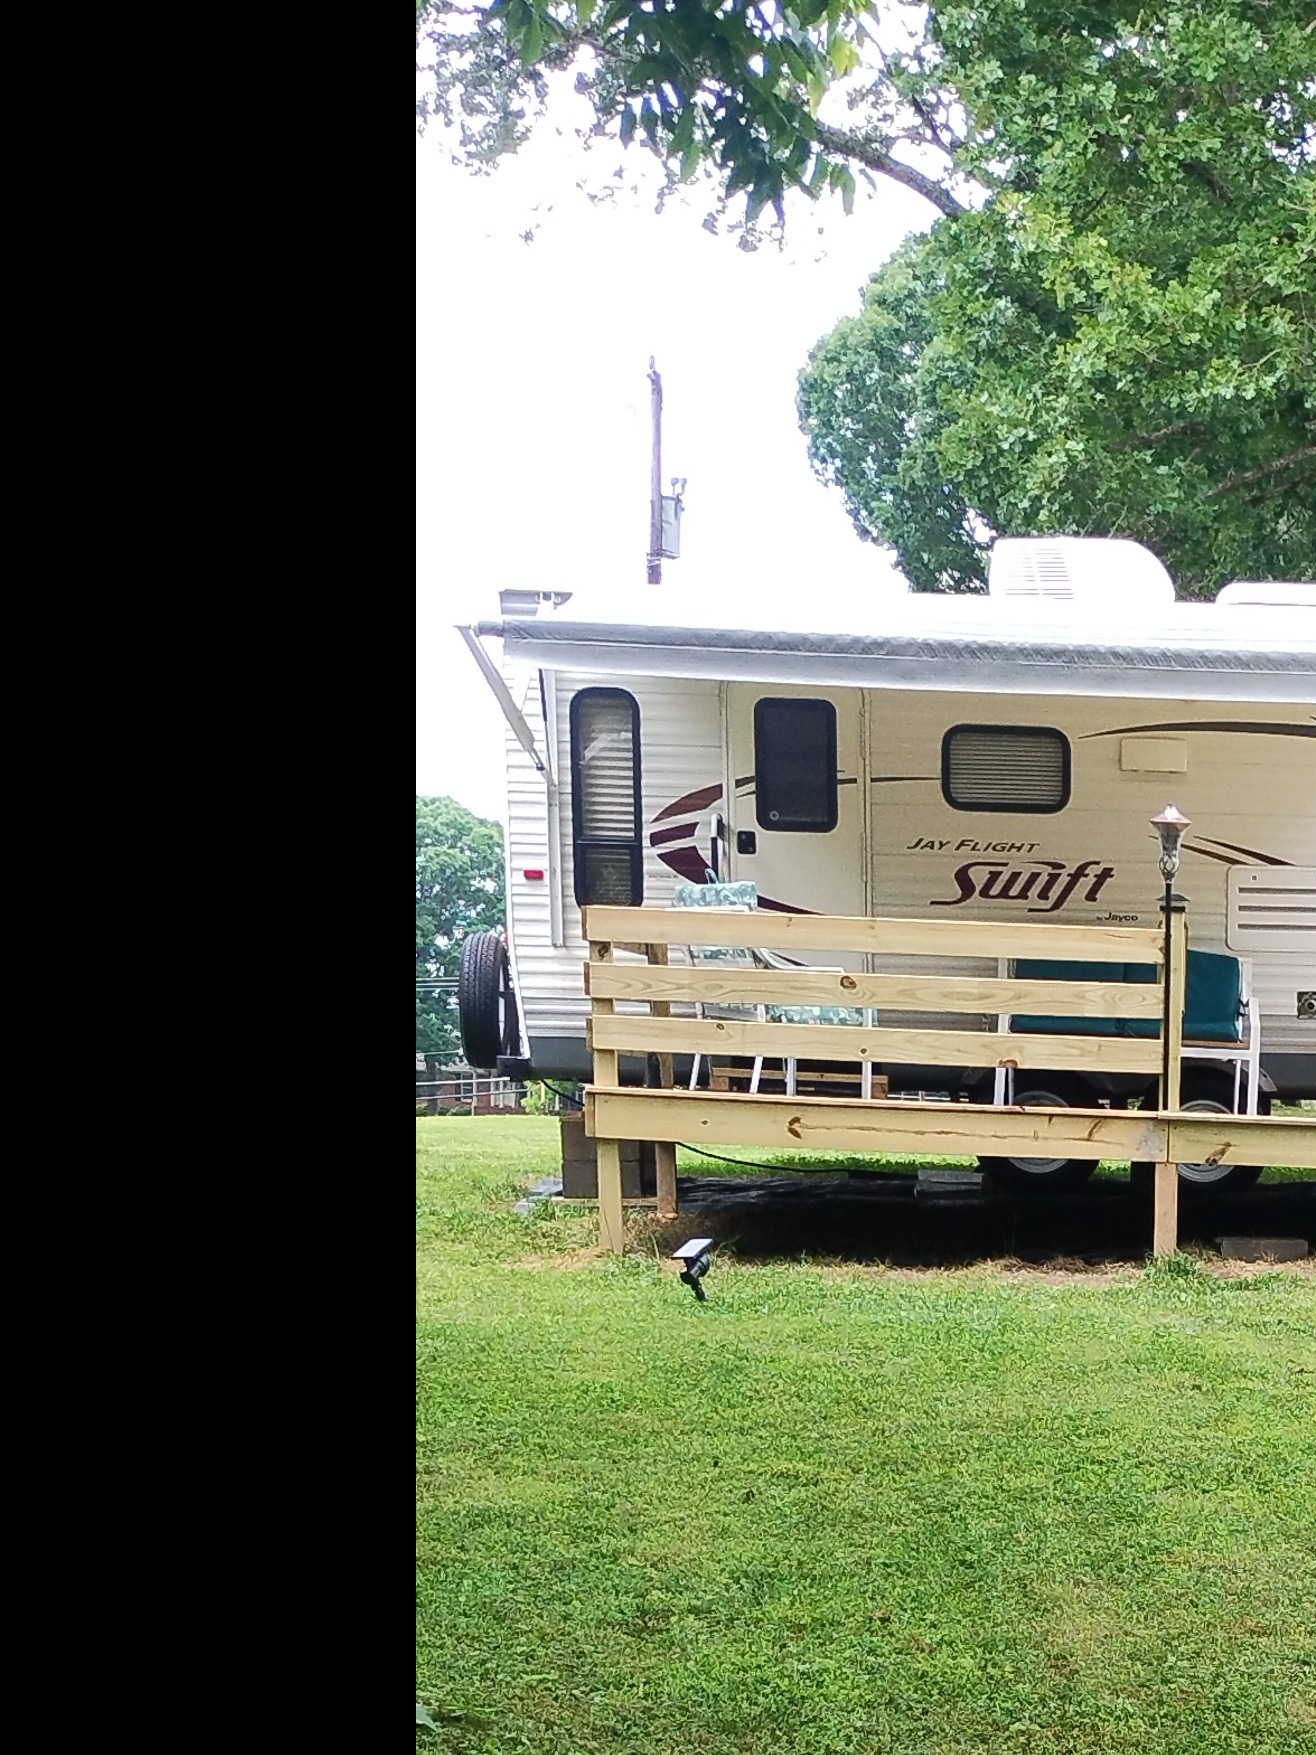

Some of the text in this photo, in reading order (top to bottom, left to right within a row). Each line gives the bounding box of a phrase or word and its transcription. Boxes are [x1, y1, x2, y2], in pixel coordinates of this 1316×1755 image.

[906, 837, 1041, 853] JAY FLIGHT
[929, 860, 1115, 912] Swift
[1104, 911, 1139, 923] Jayco
